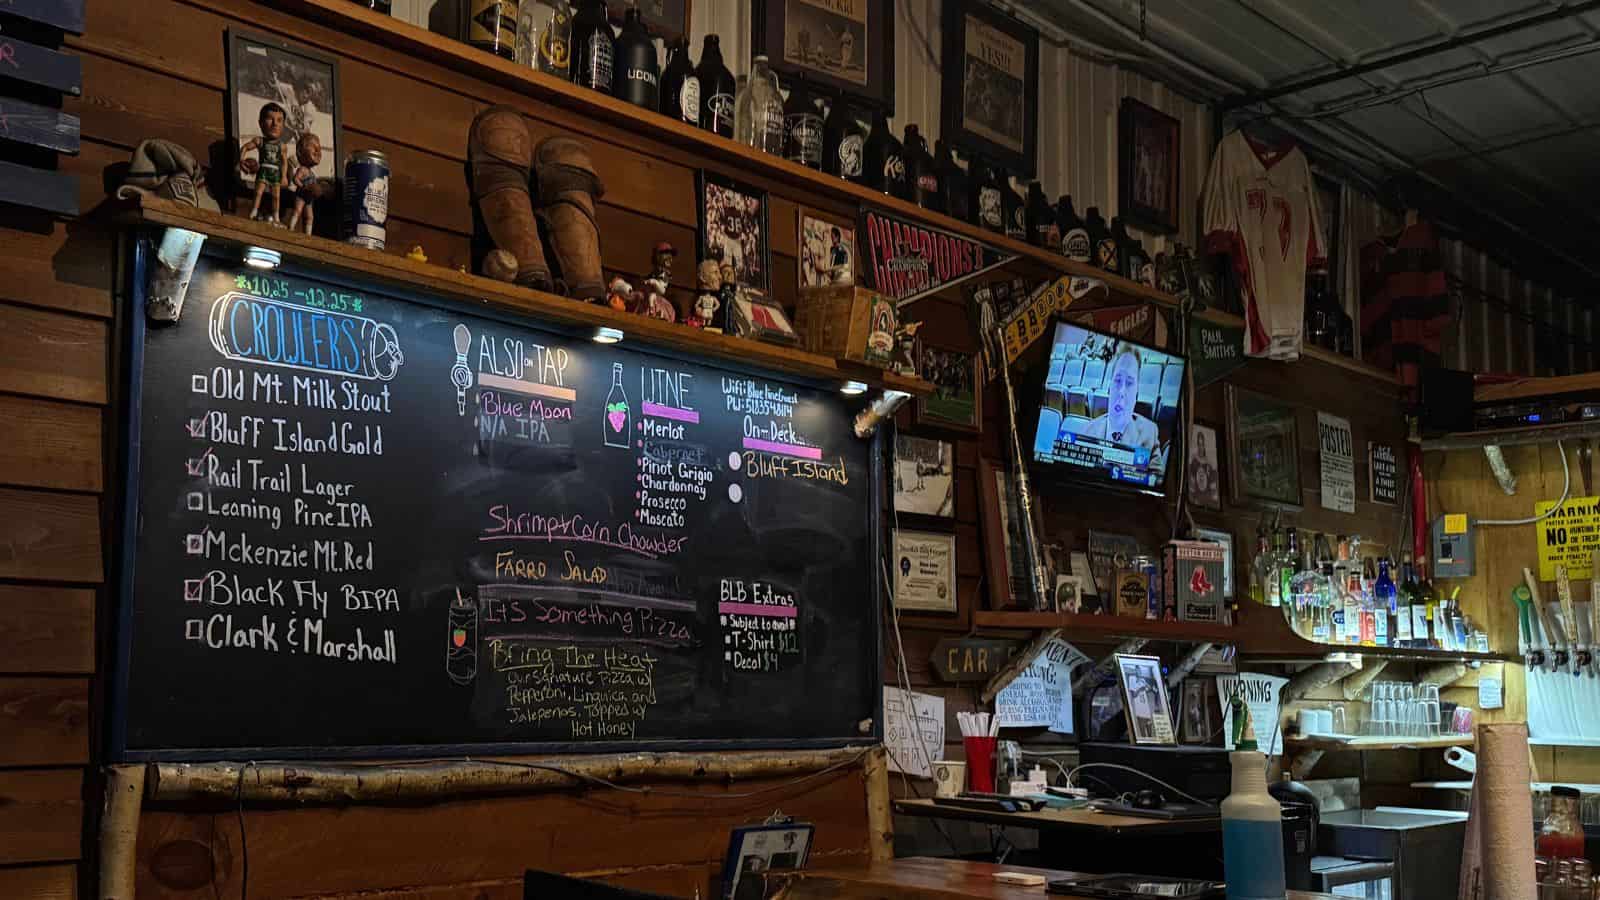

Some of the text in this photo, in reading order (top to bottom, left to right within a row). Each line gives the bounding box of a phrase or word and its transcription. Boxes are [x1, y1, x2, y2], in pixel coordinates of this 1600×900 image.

[230, 299, 361, 373] CROWLERS
[1201, 327, 1225, 345] PAUL
[479, 334, 524, 379] ALSO
[532, 343, 568, 387] TAP
[212, 366, 392, 413] Old Mt. Milk Stout
[641, 366, 694, 411] WINE
[481, 391, 572, 420] Blue Moon
[272, 418, 337, 454] Island
[341, 422, 383, 456] Gold
[480, 414, 551, 443] N/A IPA
[643, 418, 685, 440] Merlot
[1320, 422, 1352, 456] POSTED
[207, 453, 355, 505] Rail Trail Lager
[642, 457, 713, 485] Pinot Grigio
[742, 450, 849, 486] Bluff Island
[640, 491, 686, 511] Prosecco
[641, 474, 706, 500] Chardonnay
[207, 491, 281, 530] Leaning
[639, 509, 685, 528] Moscato
[205, 530, 308, 567] Mckenzie
[344, 541, 374, 571] Red
[617, 522, 689, 554] Chowder
[1547, 528, 1566, 546] NO
[207, 570, 400, 619] Black Fly BIPA
[720, 579, 794, 607] BLB Extras
[535, 596, 633, 634] Something
[639, 607, 690, 640] Pizza
[206, 613, 279, 652] Clark
[304, 617, 397, 664] Marshall
[489, 639, 659, 675] Bring The Heat
[734, 651, 779, 673] Decal $4
[597, 670, 634, 686] Pizza
[1223, 679, 1273, 703] WARNING
[583, 703, 629, 721] Topped
[571, 719, 636, 740] Hot Honey
